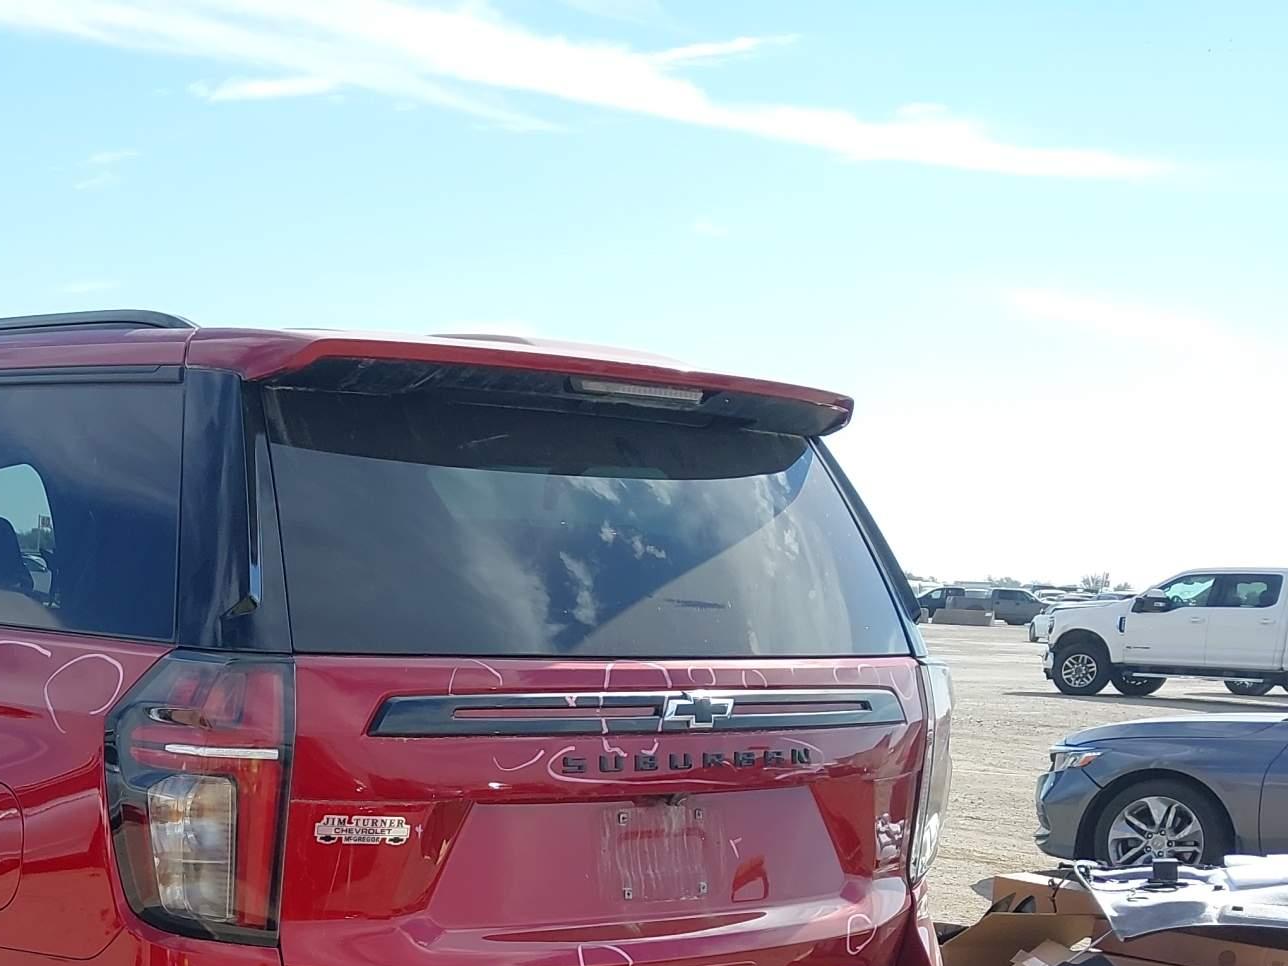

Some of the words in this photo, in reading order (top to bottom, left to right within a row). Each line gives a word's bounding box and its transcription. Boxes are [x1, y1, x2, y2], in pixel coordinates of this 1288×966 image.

[562, 748, 811, 773] SUBURBAN
[323, 817, 347, 826] JIM
[353, 818, 405, 828] TURNER
[333, 827, 393, 835] CHEVROLET
